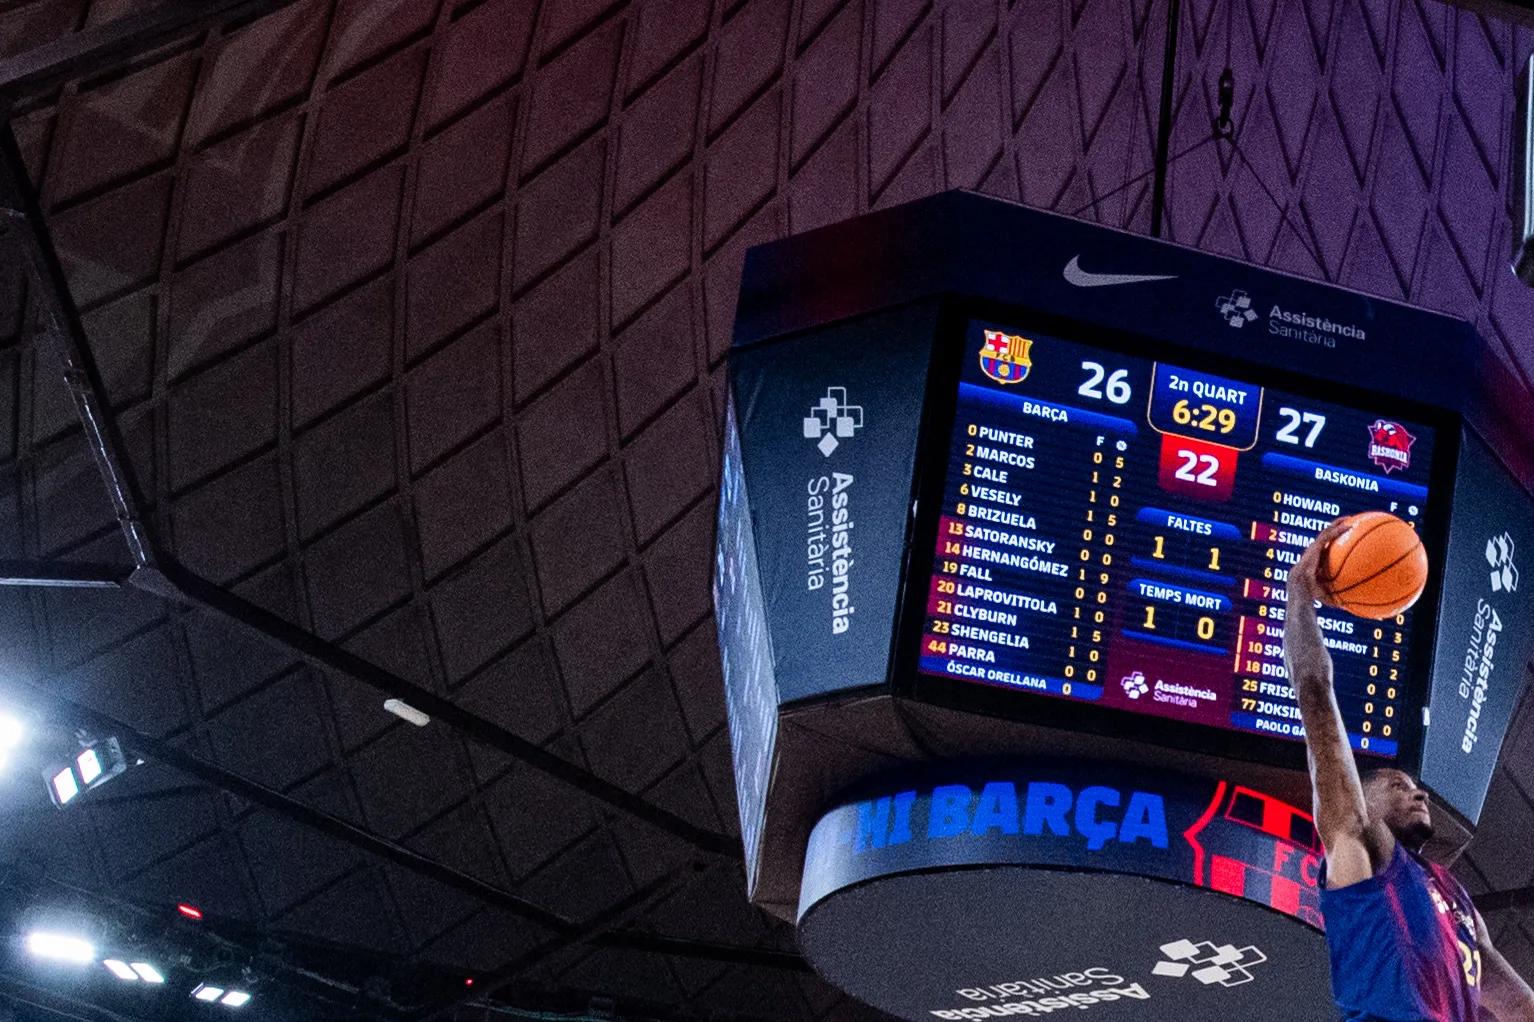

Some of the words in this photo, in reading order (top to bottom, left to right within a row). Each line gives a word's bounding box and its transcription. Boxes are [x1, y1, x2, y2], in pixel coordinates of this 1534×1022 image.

[1268, 319, 1337, 349] Sanitària
[1269, 304, 1367, 342] Assistència
[1078, 361, 1131, 404] 26
[1168, 374, 1189, 392] 2n
[1192, 380, 1247, 405] QUART
[1022, 401, 1068, 422] BARÇA
[1172, 399, 1236, 434] 6:29
[1275, 407, 1326, 448] 27
[967, 424, 977, 436] 0
[978, 426, 1034, 449] PUNTER
[1093, 452, 1103, 464] 0
[1115, 456, 1124, 469] 5
[1096, 435, 1105, 446] F
[962, 462, 972, 476] 3
[973, 465, 1008, 484] CALE
[1089, 490, 1096, 503] 1
[1110, 494, 1120, 507] 0
[965, 443, 975, 456] 2
[976, 445, 1035, 469] MARCOS
[1092, 471, 1098, 483] 1
[1112, 476, 1122, 488] 2
[1174, 449, 1219, 487] 22
[1314, 467, 1379, 492] BASKONIA
[960, 482, 969, 496] 6
[970, 484, 1022, 506] VESELY
[1086, 510, 1093, 522] 1
[1107, 514, 1117, 526] 5
[1272, 491, 1282, 504] 0
[1282, 493, 1340, 516] HOWARD
[1273, 510, 1279, 522] 1
[1390, 501, 1398, 512] F
[806, 476, 830, 591] Sanitària
[956, 502, 966, 515] 8
[967, 504, 1036, 530] BRIZUELA
[1082, 529, 1092, 541] 0
[1104, 533, 1114, 546] 0
[1167, 515, 1212, 536] FALTES
[1268, 528, 1278, 541] 2
[831, 471, 856, 635] Assistència
[944, 541, 960, 555] 14
[962, 544, 1069, 577] HERNANGÓMEZ
[1079, 568, 1085, 581] 1
[1100, 572, 1109, 585] 9
[948, 522, 964, 536] 13
[964, 524, 1056, 554] SATORANSKY
[1080, 549, 1090, 561] 0
[1102, 553, 1112, 566] 0
[1152, 536, 1165, 559] 1
[1208, 547, 1220, 570] 1
[1265, 548, 1275, 560] 4
[942, 560, 958, 574] 19
[959, 563, 993, 582] FALL
[1074, 586, 1085, 599] 0
[1097, 591, 1107, 604] 0
[1262, 586, 1271, 598] 7
[1264, 567, 1273, 578] 6
[936, 580, 955, 594] 20
[956, 583, 1057, 614] LAPROVITTOLA
[1074, 606, 1080, 619] 1
[1094, 610, 1104, 623] 0
[1139, 583, 1182, 602] TEMPS
[1184, 592, 1222, 610] MORT
[936, 600, 952, 614] 21
[953, 603, 1017, 626] CLYBURN
[1070, 626, 1078, 638] 1
[1092, 630, 1101, 642] 5
[1142, 606, 1156, 629] 1
[1196, 616, 1214, 640] 0
[1258, 604, 1268, 617] 8
[1373, 628, 1382, 640] 0
[1394, 632, 1402, 644] 3
[932, 620, 950, 634] 23
[950, 623, 1029, 649] SHENGELIA
[1068, 646, 1075, 658] 1
[1089, 650, 1099, 662] 0
[1256, 623, 1266, 635] 9
[1372, 646, 1378, 658] 1
[1391, 650, 1400, 662] 5
[1457, 597, 1491, 700] Sanitària
[928, 640, 947, 654] 44
[948, 642, 995, 663] PARRA
[1064, 665, 1074, 678] 0
[1086, 669, 1096, 682] 0
[946, 659, 986, 678] ÓSCAR
[987, 669, 1047, 690] ORELLANA
[1062, 682, 1072, 696] 0
[1245, 660, 1261, 673] 18
[1366, 683, 1376, 696] 0
[1386, 687, 1396, 699] 0
[1248, 641, 1263, 654] 10
[1369, 664, 1378, 677] 0
[1389, 668, 1398, 681] 2
[1153, 690, 1197, 708] Sanitària
[1154, 679, 1217, 701] Assistència
[1242, 678, 1258, 692] 25
[1364, 702, 1374, 714] 0
[1384, 706, 1394, 718] 0
[1460, 608, 1503, 754] Assistència
[1241, 698, 1257, 711] 77
[1362, 720, 1372, 733] 0
[1382, 724, 1392, 737] 0
[1255, 719, 1291, 735] PAOLO
[1360, 736, 1370, 750] 0
[928, 781, 1169, 851] BARÇA
[928, 982, 1151, 1022] Assistència
[956, 966, 1125, 1002] Sanitària
